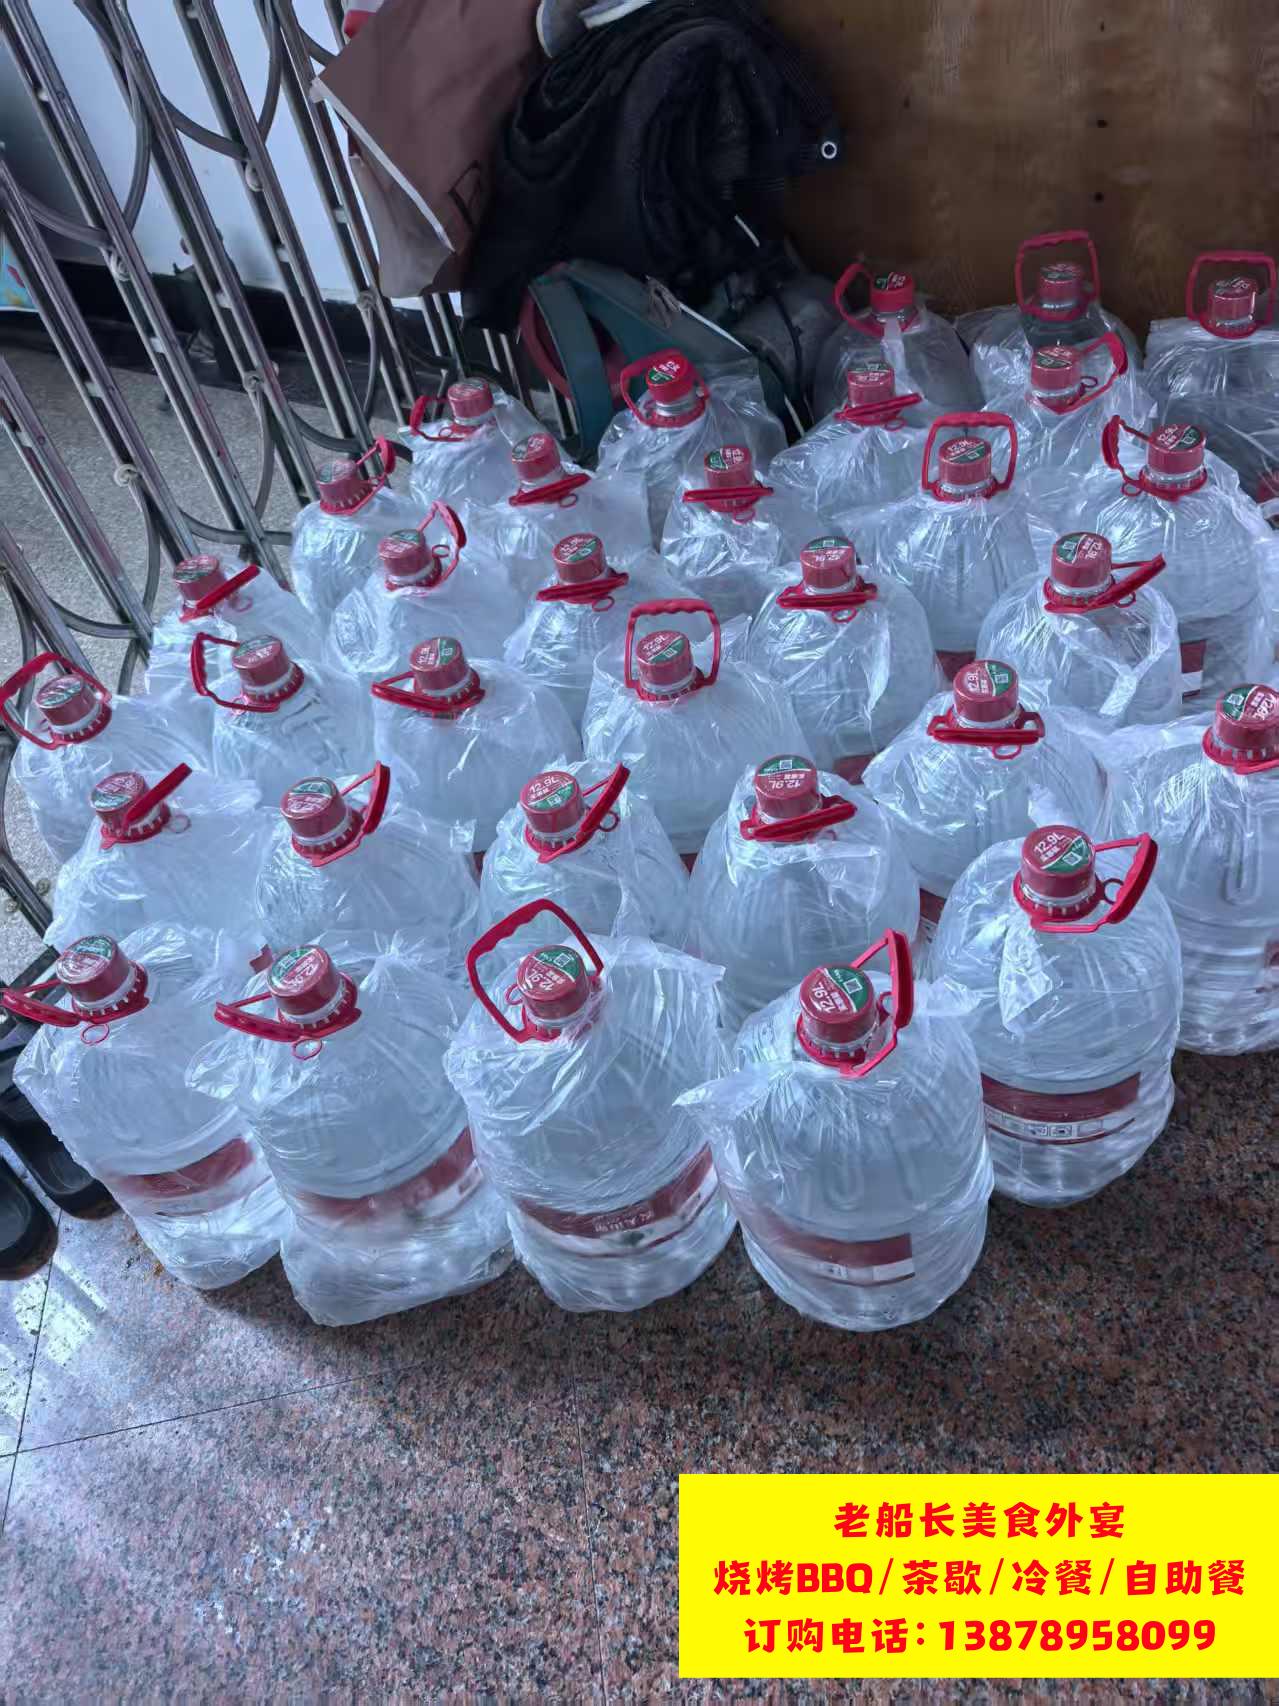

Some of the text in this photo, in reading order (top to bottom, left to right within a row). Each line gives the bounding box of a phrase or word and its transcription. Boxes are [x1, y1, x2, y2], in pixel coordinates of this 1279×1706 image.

[529, 776, 559, 793] 12.9L
[769, 780, 801, 789] 12.9L
[1034, 832, 1065, 853] 12.9L
[812, 982, 836, 1012] 12.9L
